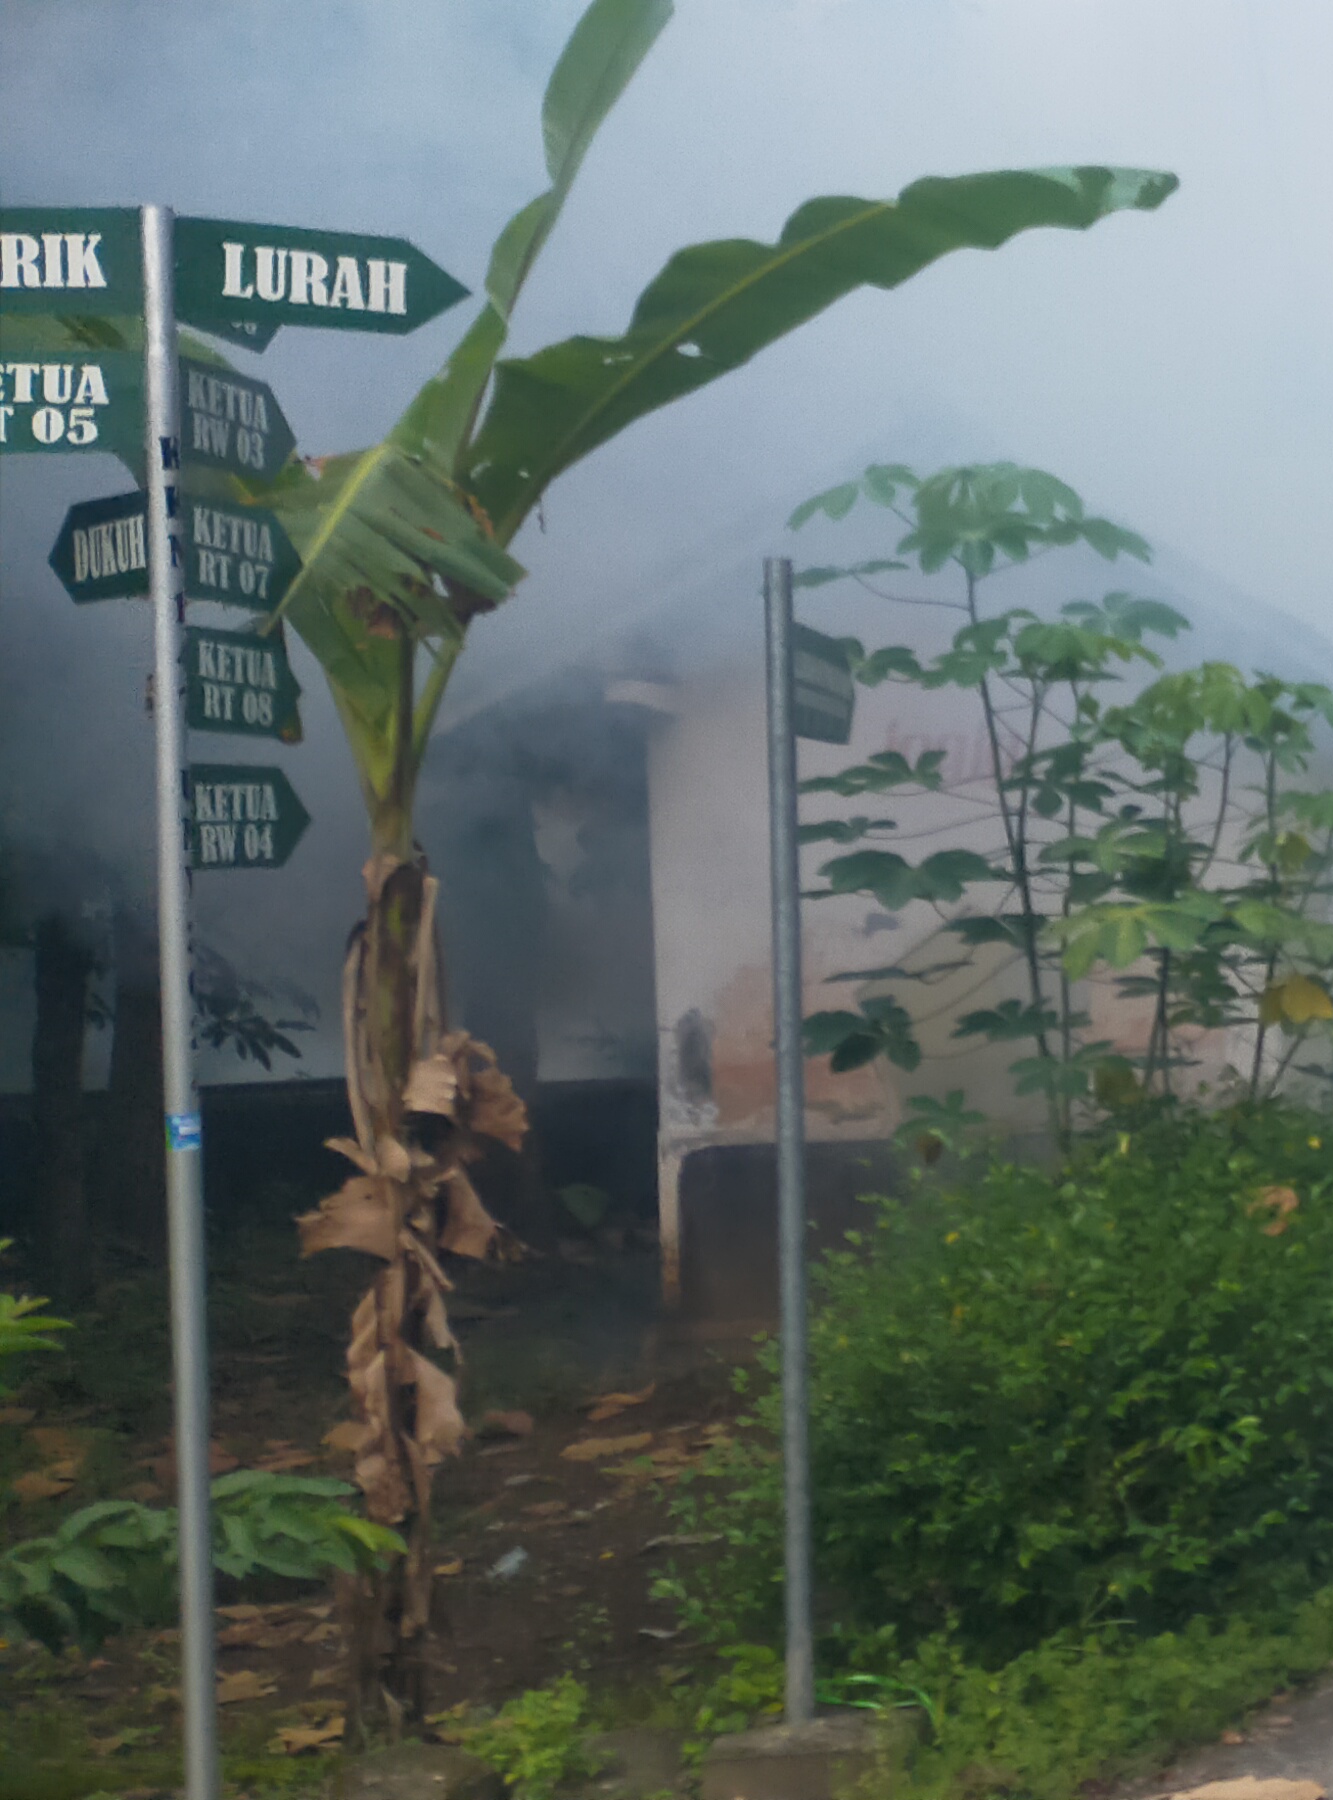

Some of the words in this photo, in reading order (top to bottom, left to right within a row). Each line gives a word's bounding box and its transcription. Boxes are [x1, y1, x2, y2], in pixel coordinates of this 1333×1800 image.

[222, 241, 407, 315] LURAH
[0, 363, 109, 404] TUA
[189, 369, 269, 434] KETUA
[32, 404, 98, 444] 05
[193, 412, 229, 458] RW
[237, 427, 264, 470] 03
[73, 514, 146, 582] DUKUH
[193, 506, 273, 563] KETUA
[199, 549, 230, 589] RT
[239, 565, 269, 600] 07
[198, 639, 275, 690] KETUA
[203, 682, 233, 720] RT
[242, 691, 273, 727] 08
[195, 783, 278, 822] KETUA
[201, 824, 235, 863] RW
[243, 824, 274, 860] 04
